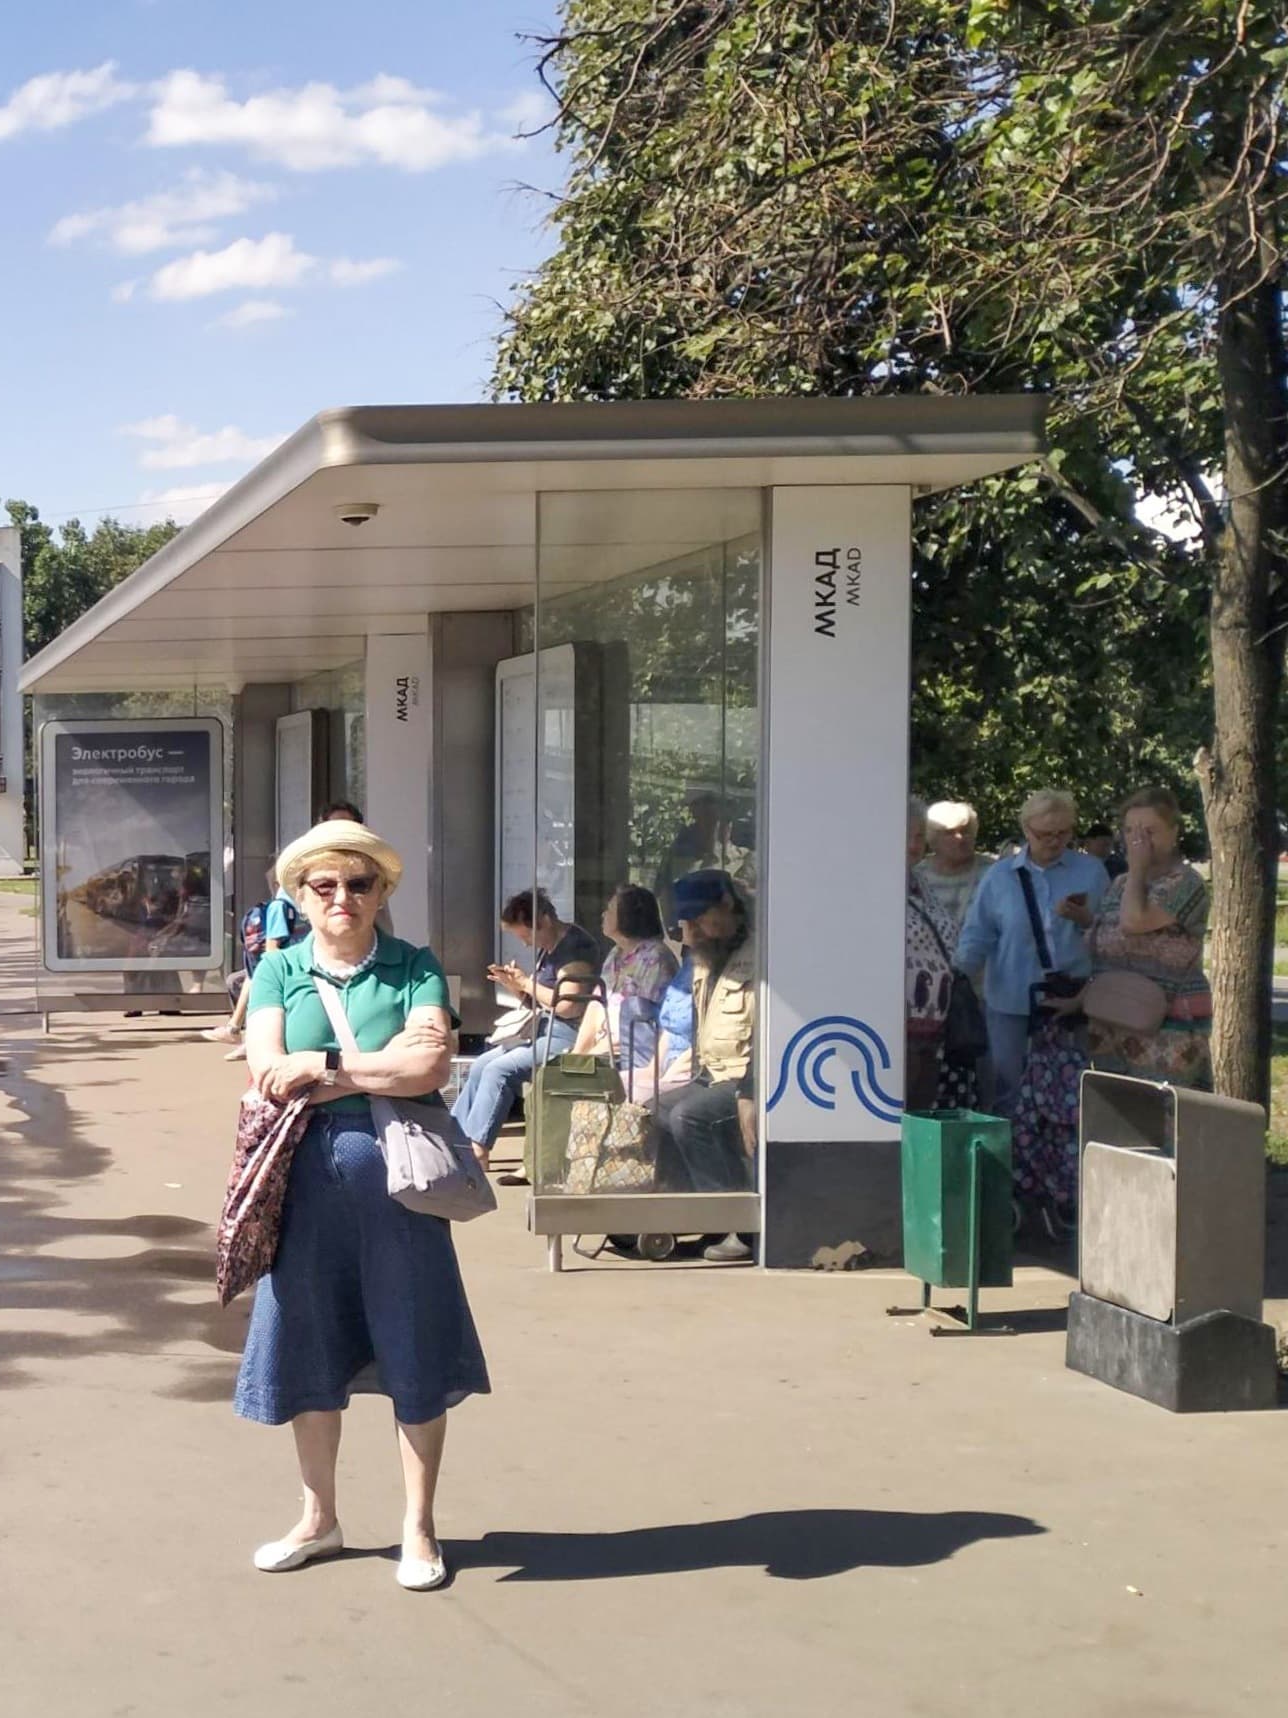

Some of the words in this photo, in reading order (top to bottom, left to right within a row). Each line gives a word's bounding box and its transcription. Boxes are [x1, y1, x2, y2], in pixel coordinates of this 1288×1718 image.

[814, 548, 841, 638] МКАД
[846, 547, 861, 606] MKAD
[396, 676, 409, 722] МКАД
[71, 745, 163, 762] Электробус
